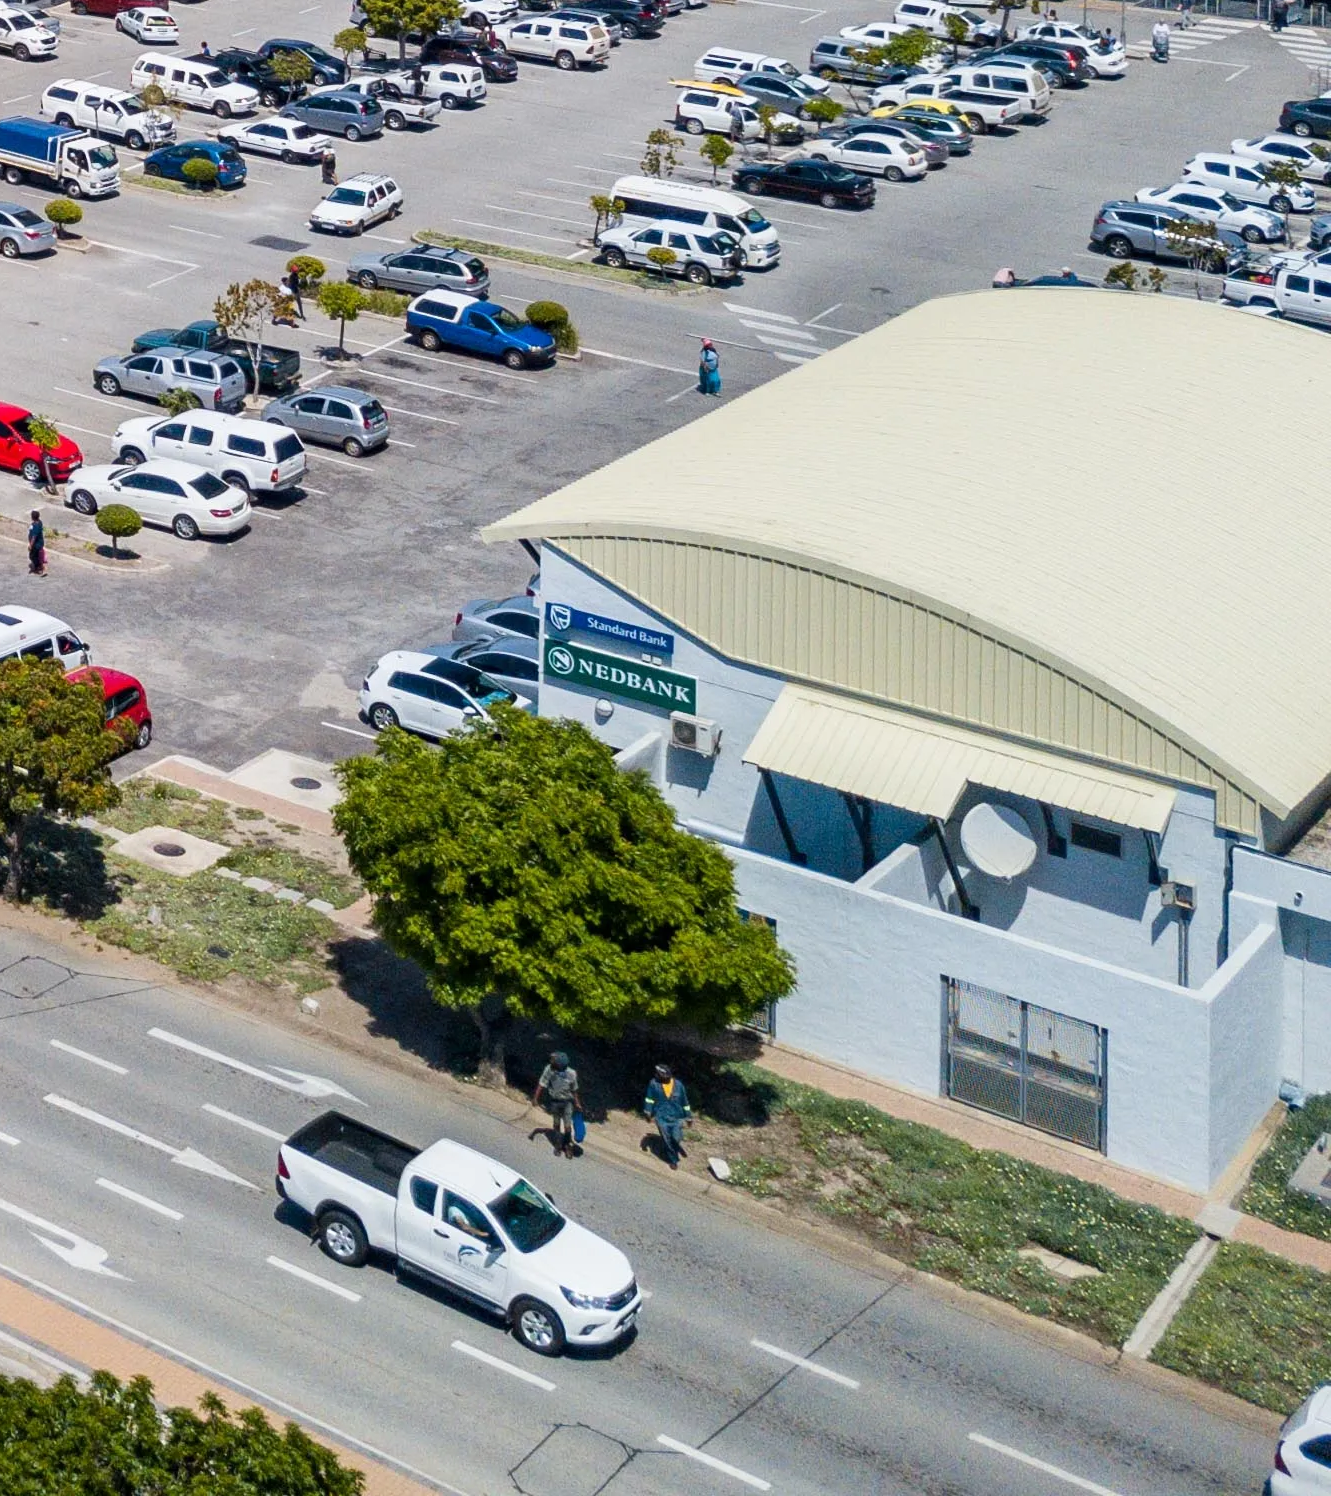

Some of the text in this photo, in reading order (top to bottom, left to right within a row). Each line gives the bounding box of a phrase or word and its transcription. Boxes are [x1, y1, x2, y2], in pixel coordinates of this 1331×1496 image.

[587, 617, 667, 648] Standard Bank
[579, 658, 692, 704] NEDBANK
